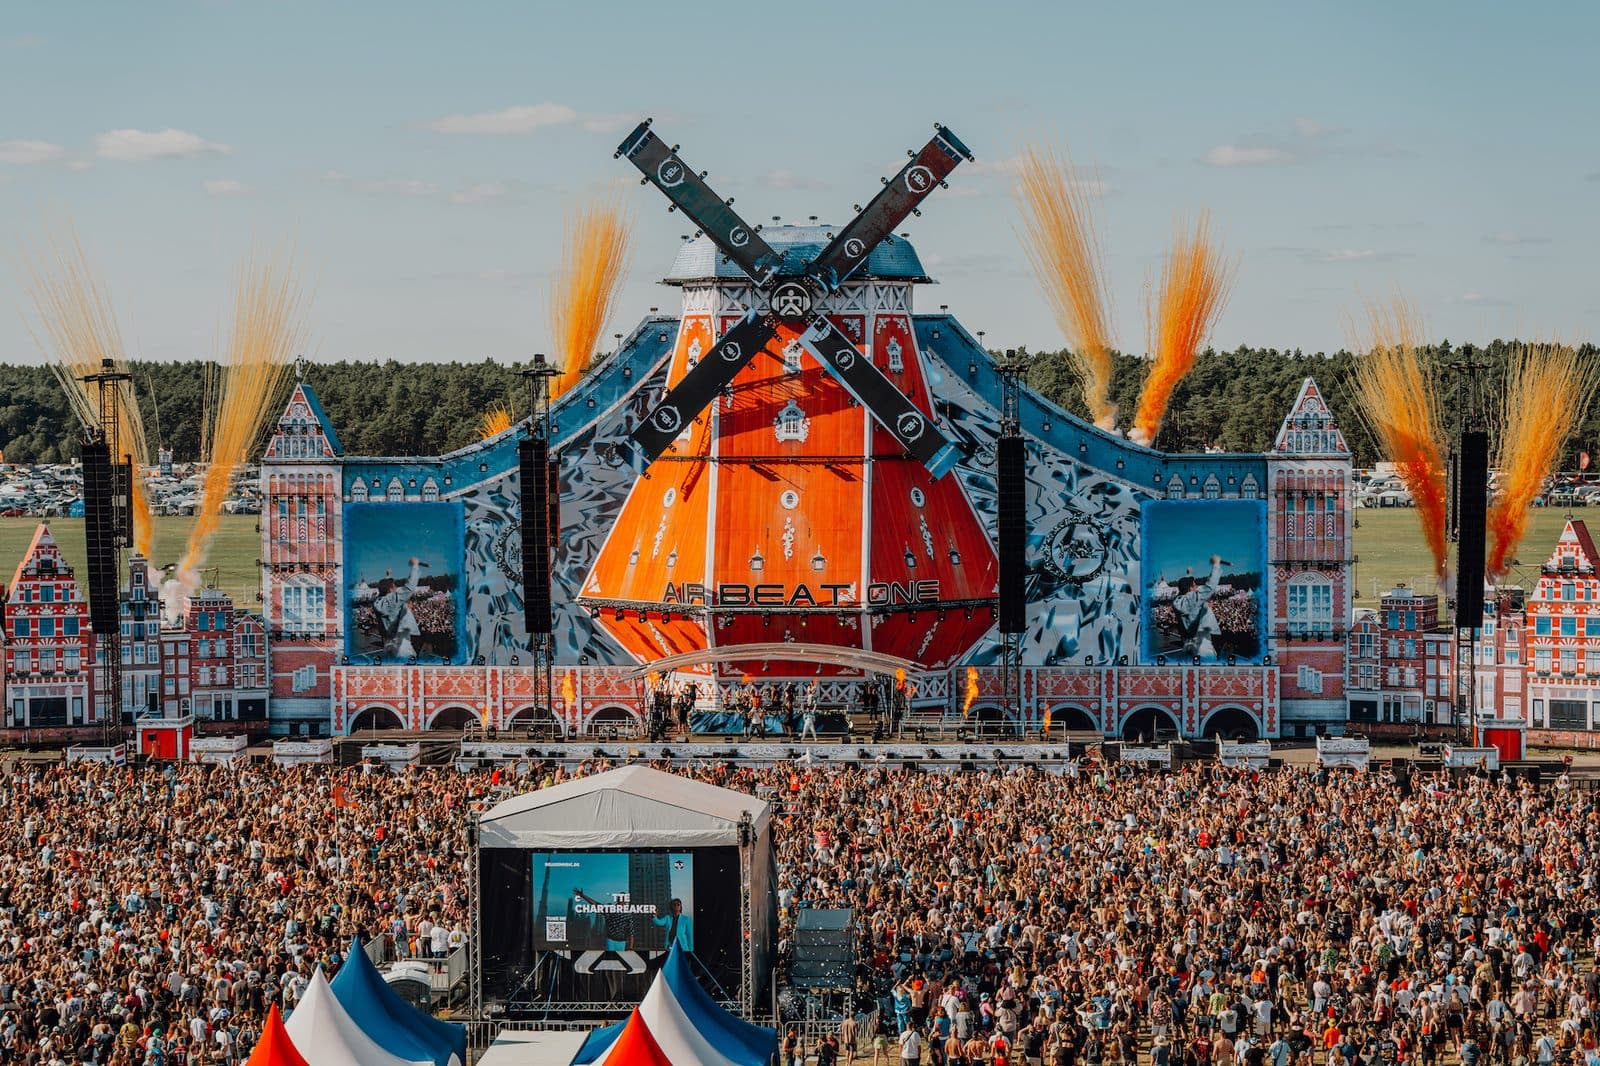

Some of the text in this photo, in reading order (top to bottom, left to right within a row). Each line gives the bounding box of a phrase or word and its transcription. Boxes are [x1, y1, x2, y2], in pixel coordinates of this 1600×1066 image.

[719, 584, 851, 606] BEAT
[867, 580, 939, 605] ONE
[575, 904, 657, 913] CHARTBREAKER
